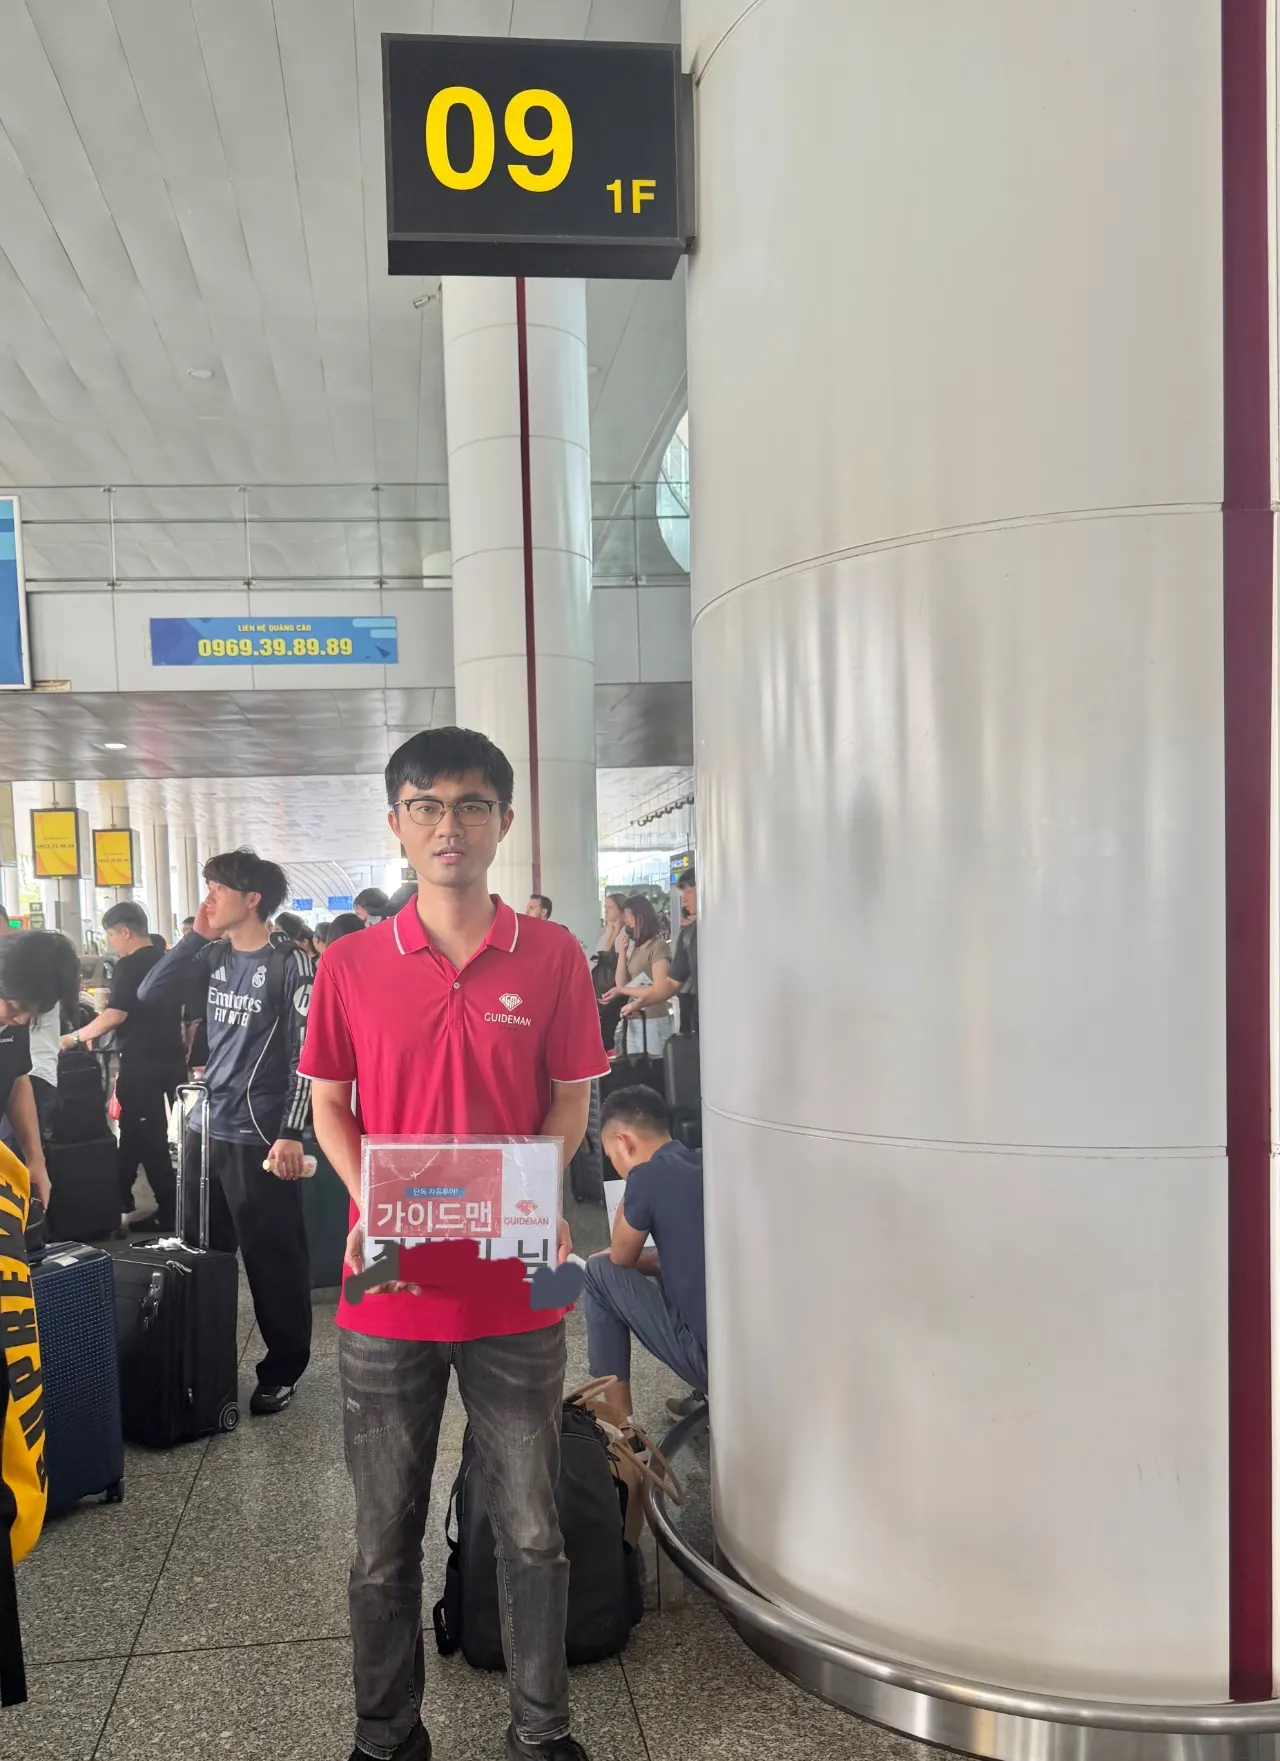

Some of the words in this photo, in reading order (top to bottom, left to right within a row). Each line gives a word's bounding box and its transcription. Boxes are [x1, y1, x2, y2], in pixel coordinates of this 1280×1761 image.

[425, 86, 574, 192] 09
[606, 179, 656, 213] 1F
[197, 638, 353, 657] 0969.39.89.89
[484, 1012, 532, 1026] GUIDEMAN
[377, 1201, 492, 1233] 가이드맨
[503, 1217, 549, 1225] GUIDEMAN
